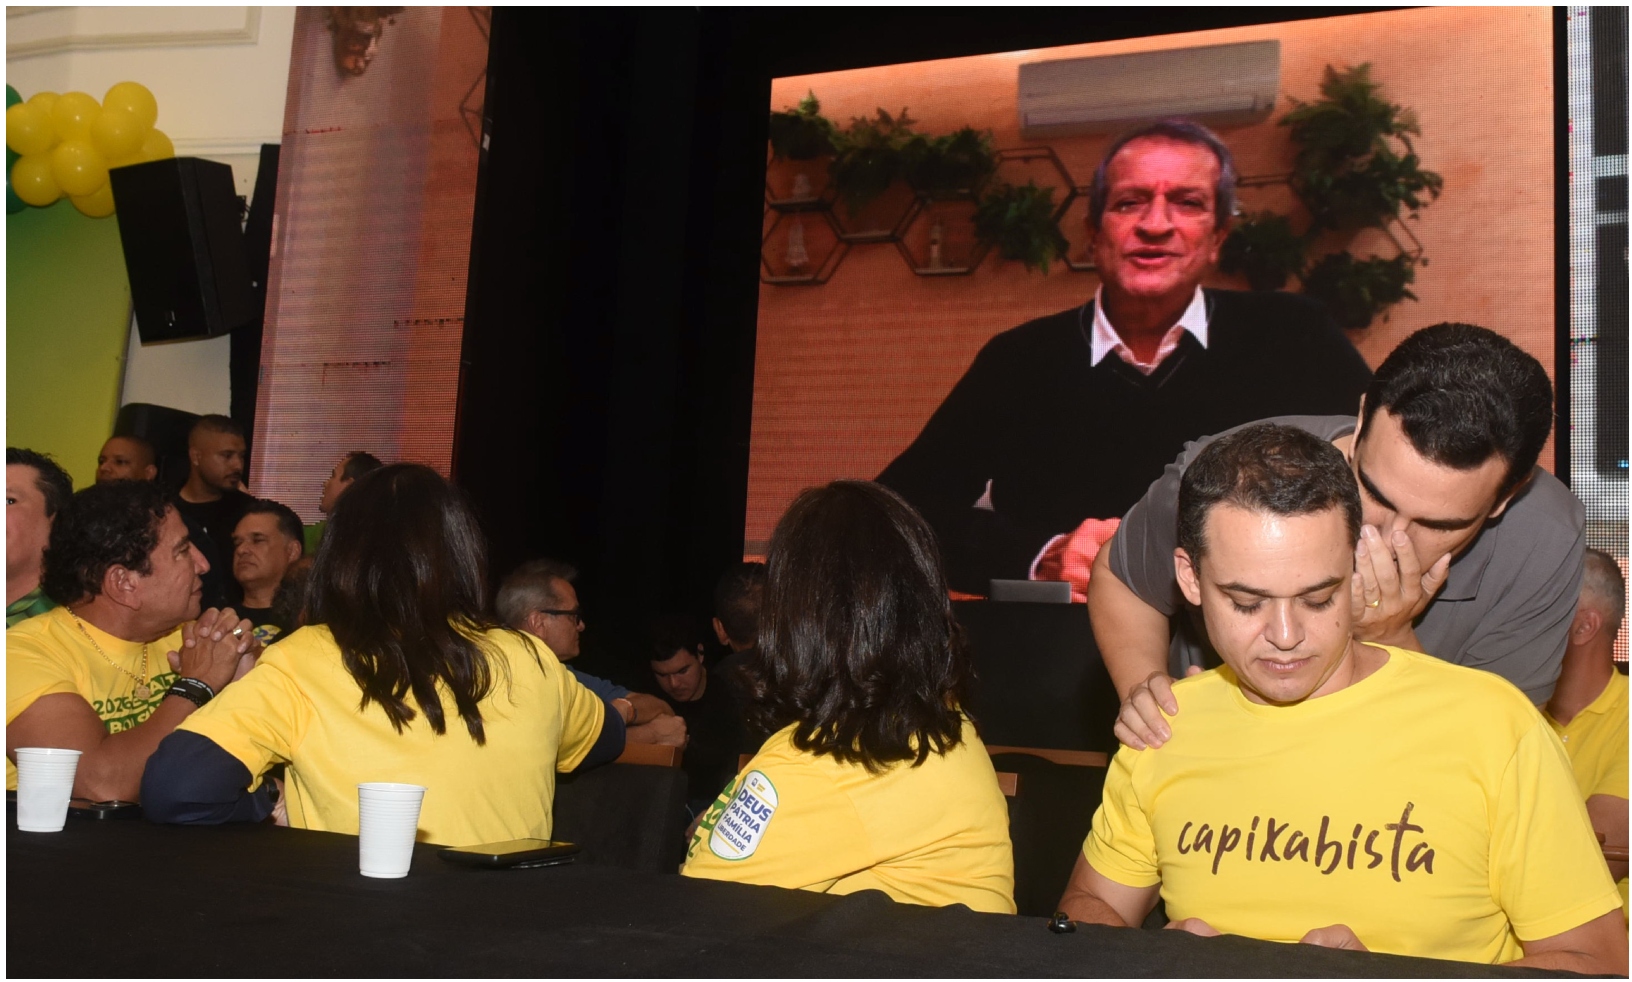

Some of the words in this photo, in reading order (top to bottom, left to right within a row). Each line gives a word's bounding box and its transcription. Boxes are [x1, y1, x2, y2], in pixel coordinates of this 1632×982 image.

[730, 802, 761, 834] PÁTRIA
[737, 788, 772, 822] DEUS
[722, 813, 752, 844] FAMÍLIA
[1177, 801, 1434, 883] capixabista
